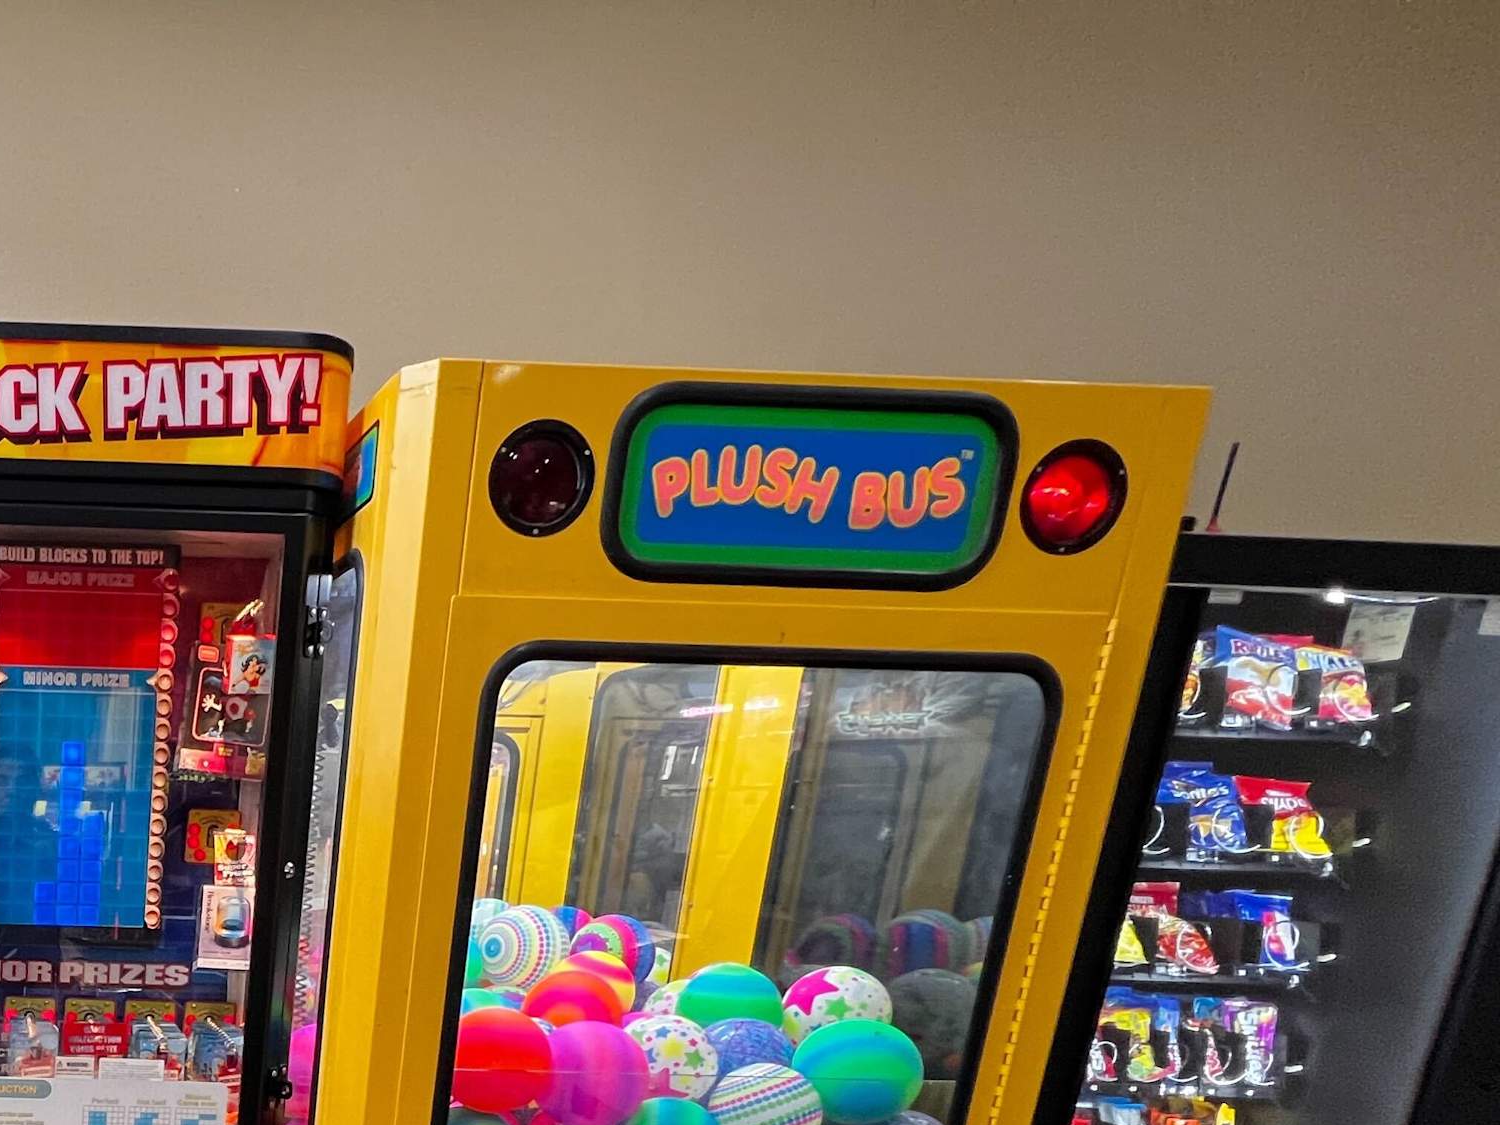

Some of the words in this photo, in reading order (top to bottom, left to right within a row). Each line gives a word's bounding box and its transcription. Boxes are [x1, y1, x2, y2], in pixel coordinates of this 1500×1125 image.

[104, 353, 323, 440] PARTY!
[652, 444, 840, 524] PLUSH
[848, 456, 966, 530] BUS
[39, 547, 88, 563] BLOCKS
[92, 548, 107, 564] TO
[111, 549, 133, 565] THE
[136, 550, 165, 566] TOP!
[26, 570, 84, 586] MAJOR
[86, 572, 135, 587] PRIZE
[22, 671, 77, 687] MINOR
[81, 673, 130, 688] PRIZE
[59, 961, 190, 986] PRIZES
